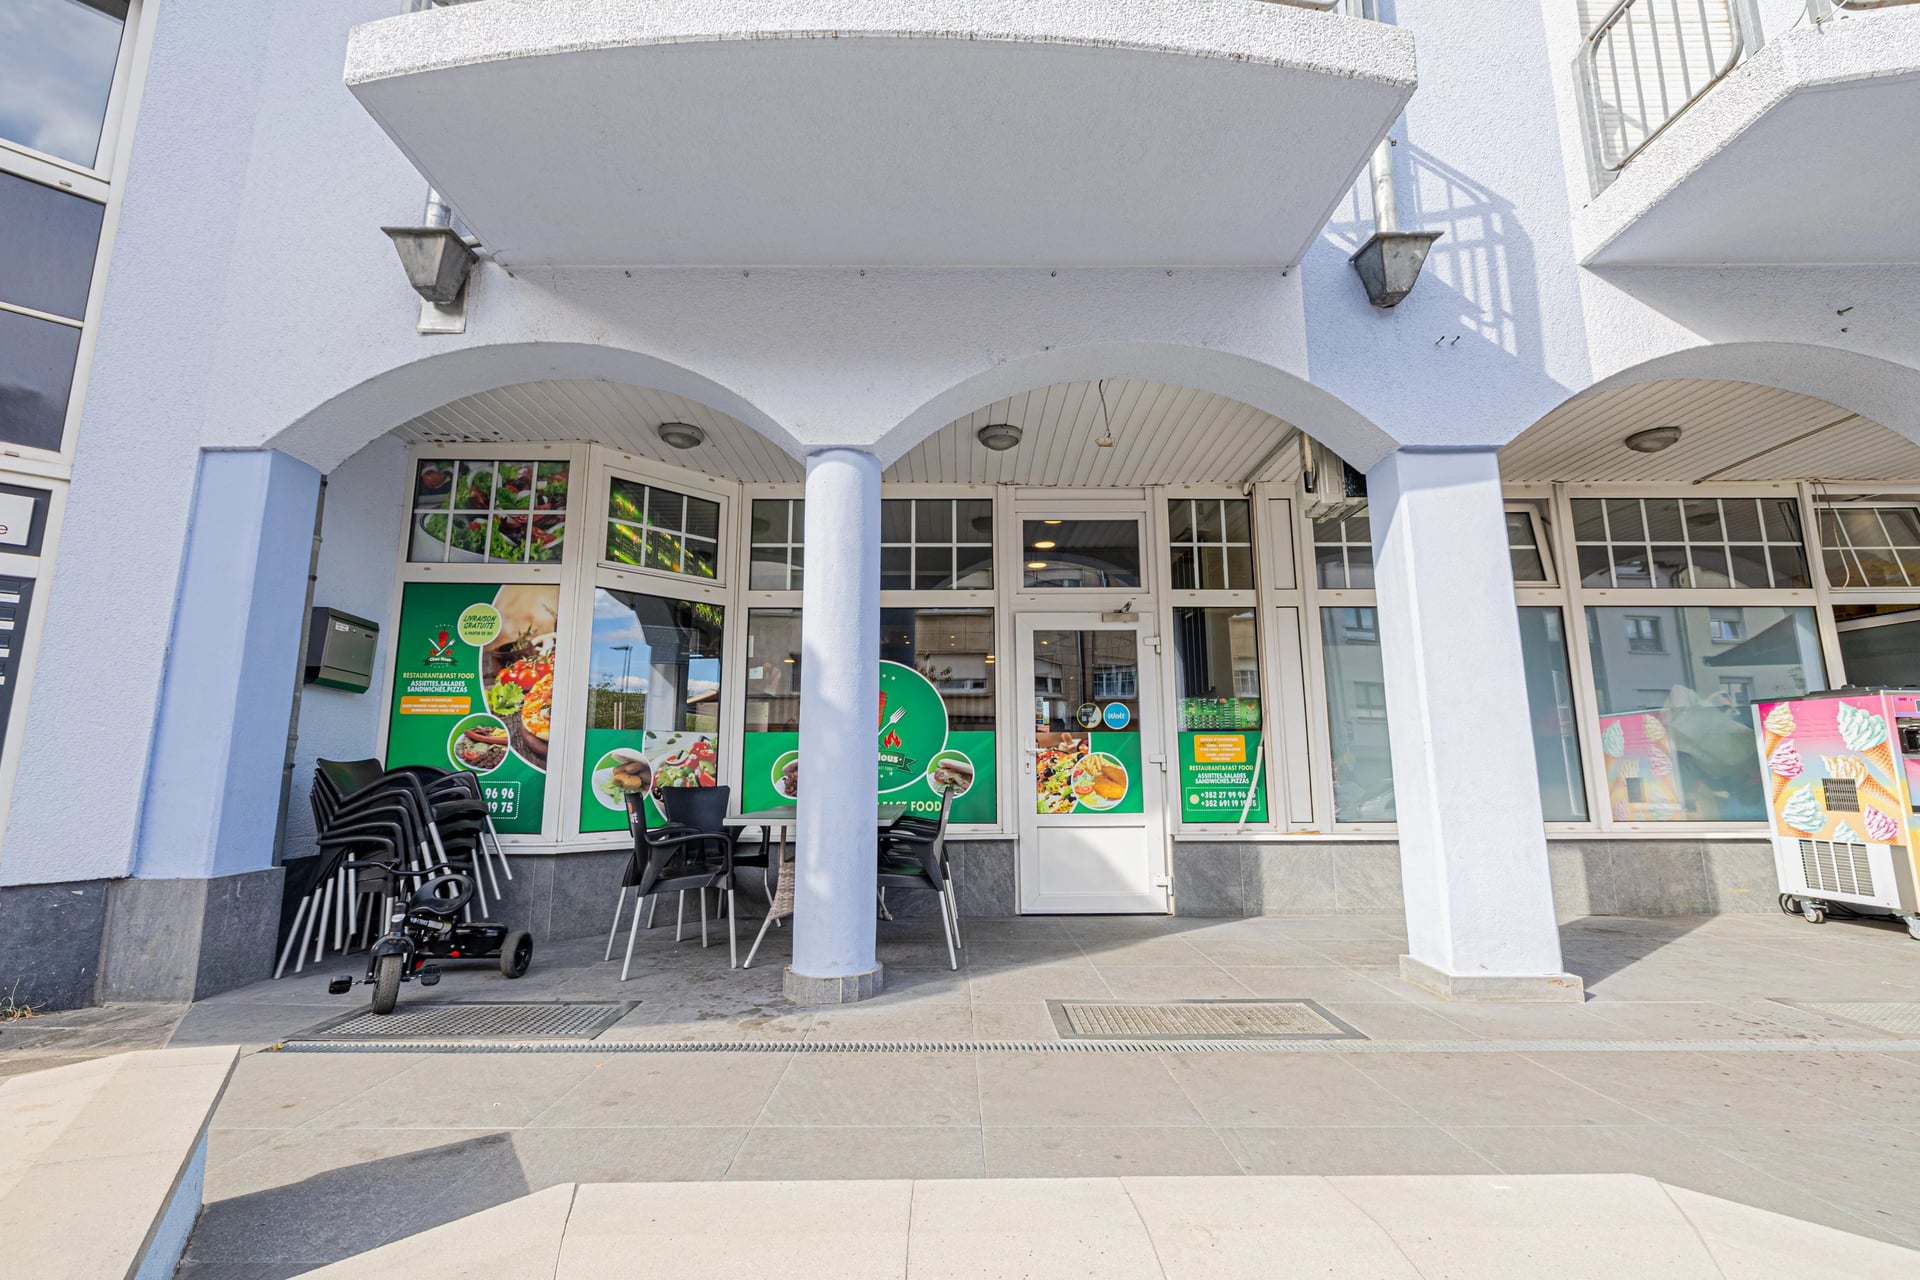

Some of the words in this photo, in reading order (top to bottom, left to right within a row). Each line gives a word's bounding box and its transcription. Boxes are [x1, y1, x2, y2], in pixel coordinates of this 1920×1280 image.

[1108, 712, 1125, 720] Wolt
[485, 787, 498, 799] 96
[501, 787, 514, 799] 96
[1200, 791, 1217, 799] +352
[1218, 791, 1227, 799] 27
[1228, 791, 1237, 799] 99
[1237, 791, 1247, 799] 96
[487, 801, 498, 813] 19
[501, 801, 514, 813] 75
[911, 800, 942, 812] FOOD
